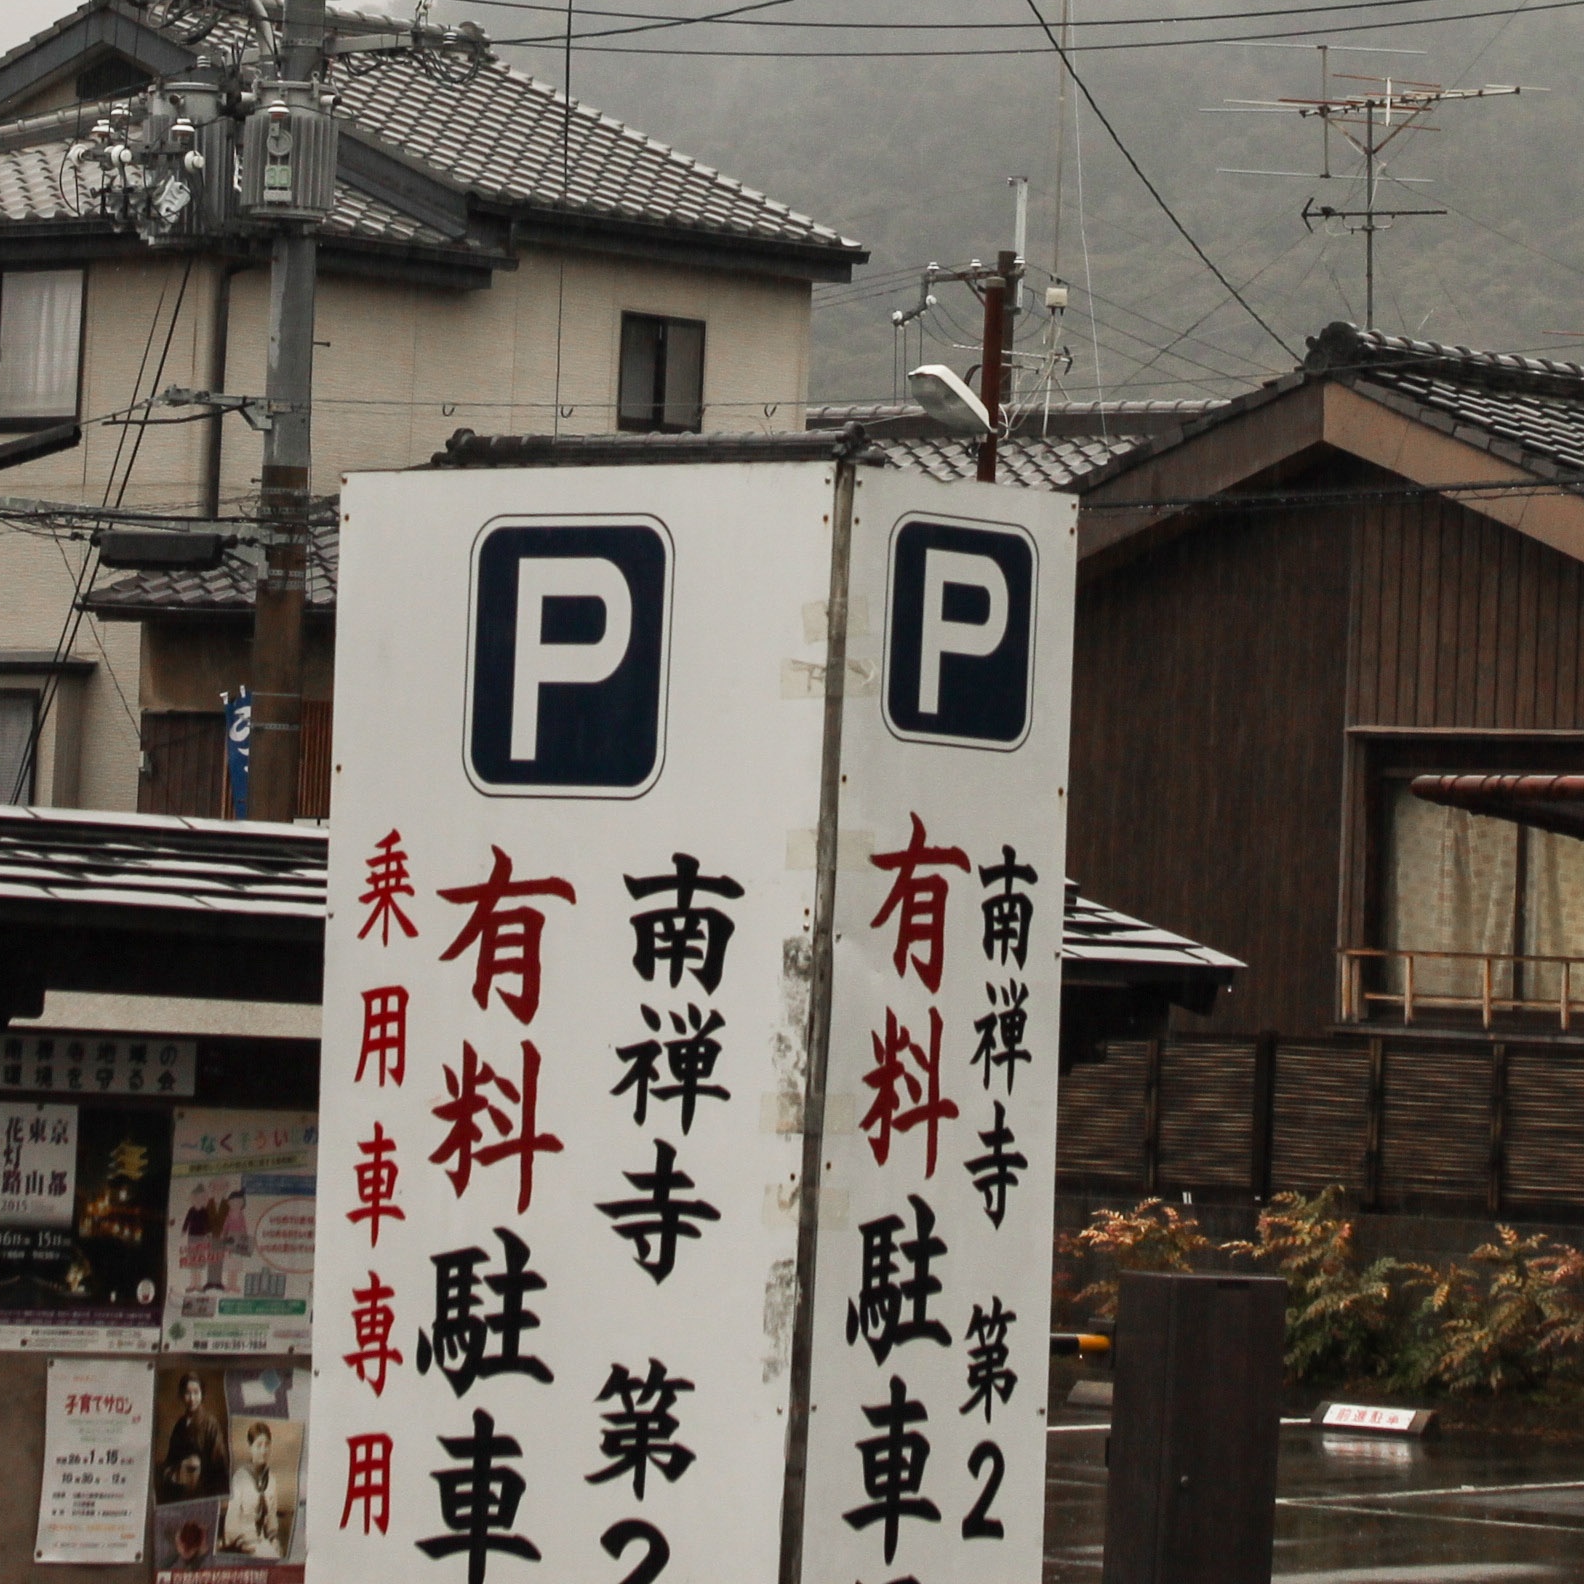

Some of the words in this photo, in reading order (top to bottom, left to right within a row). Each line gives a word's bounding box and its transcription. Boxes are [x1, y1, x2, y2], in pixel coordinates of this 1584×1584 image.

[510, 555, 634, 762] P
[918, 548, 1011, 715] P
[340, 828, 417, 1536] 乗用車専用
[843, 811, 972, 1584] 有料駐車
[65, 1393, 133, 1416] 子育てサロン
